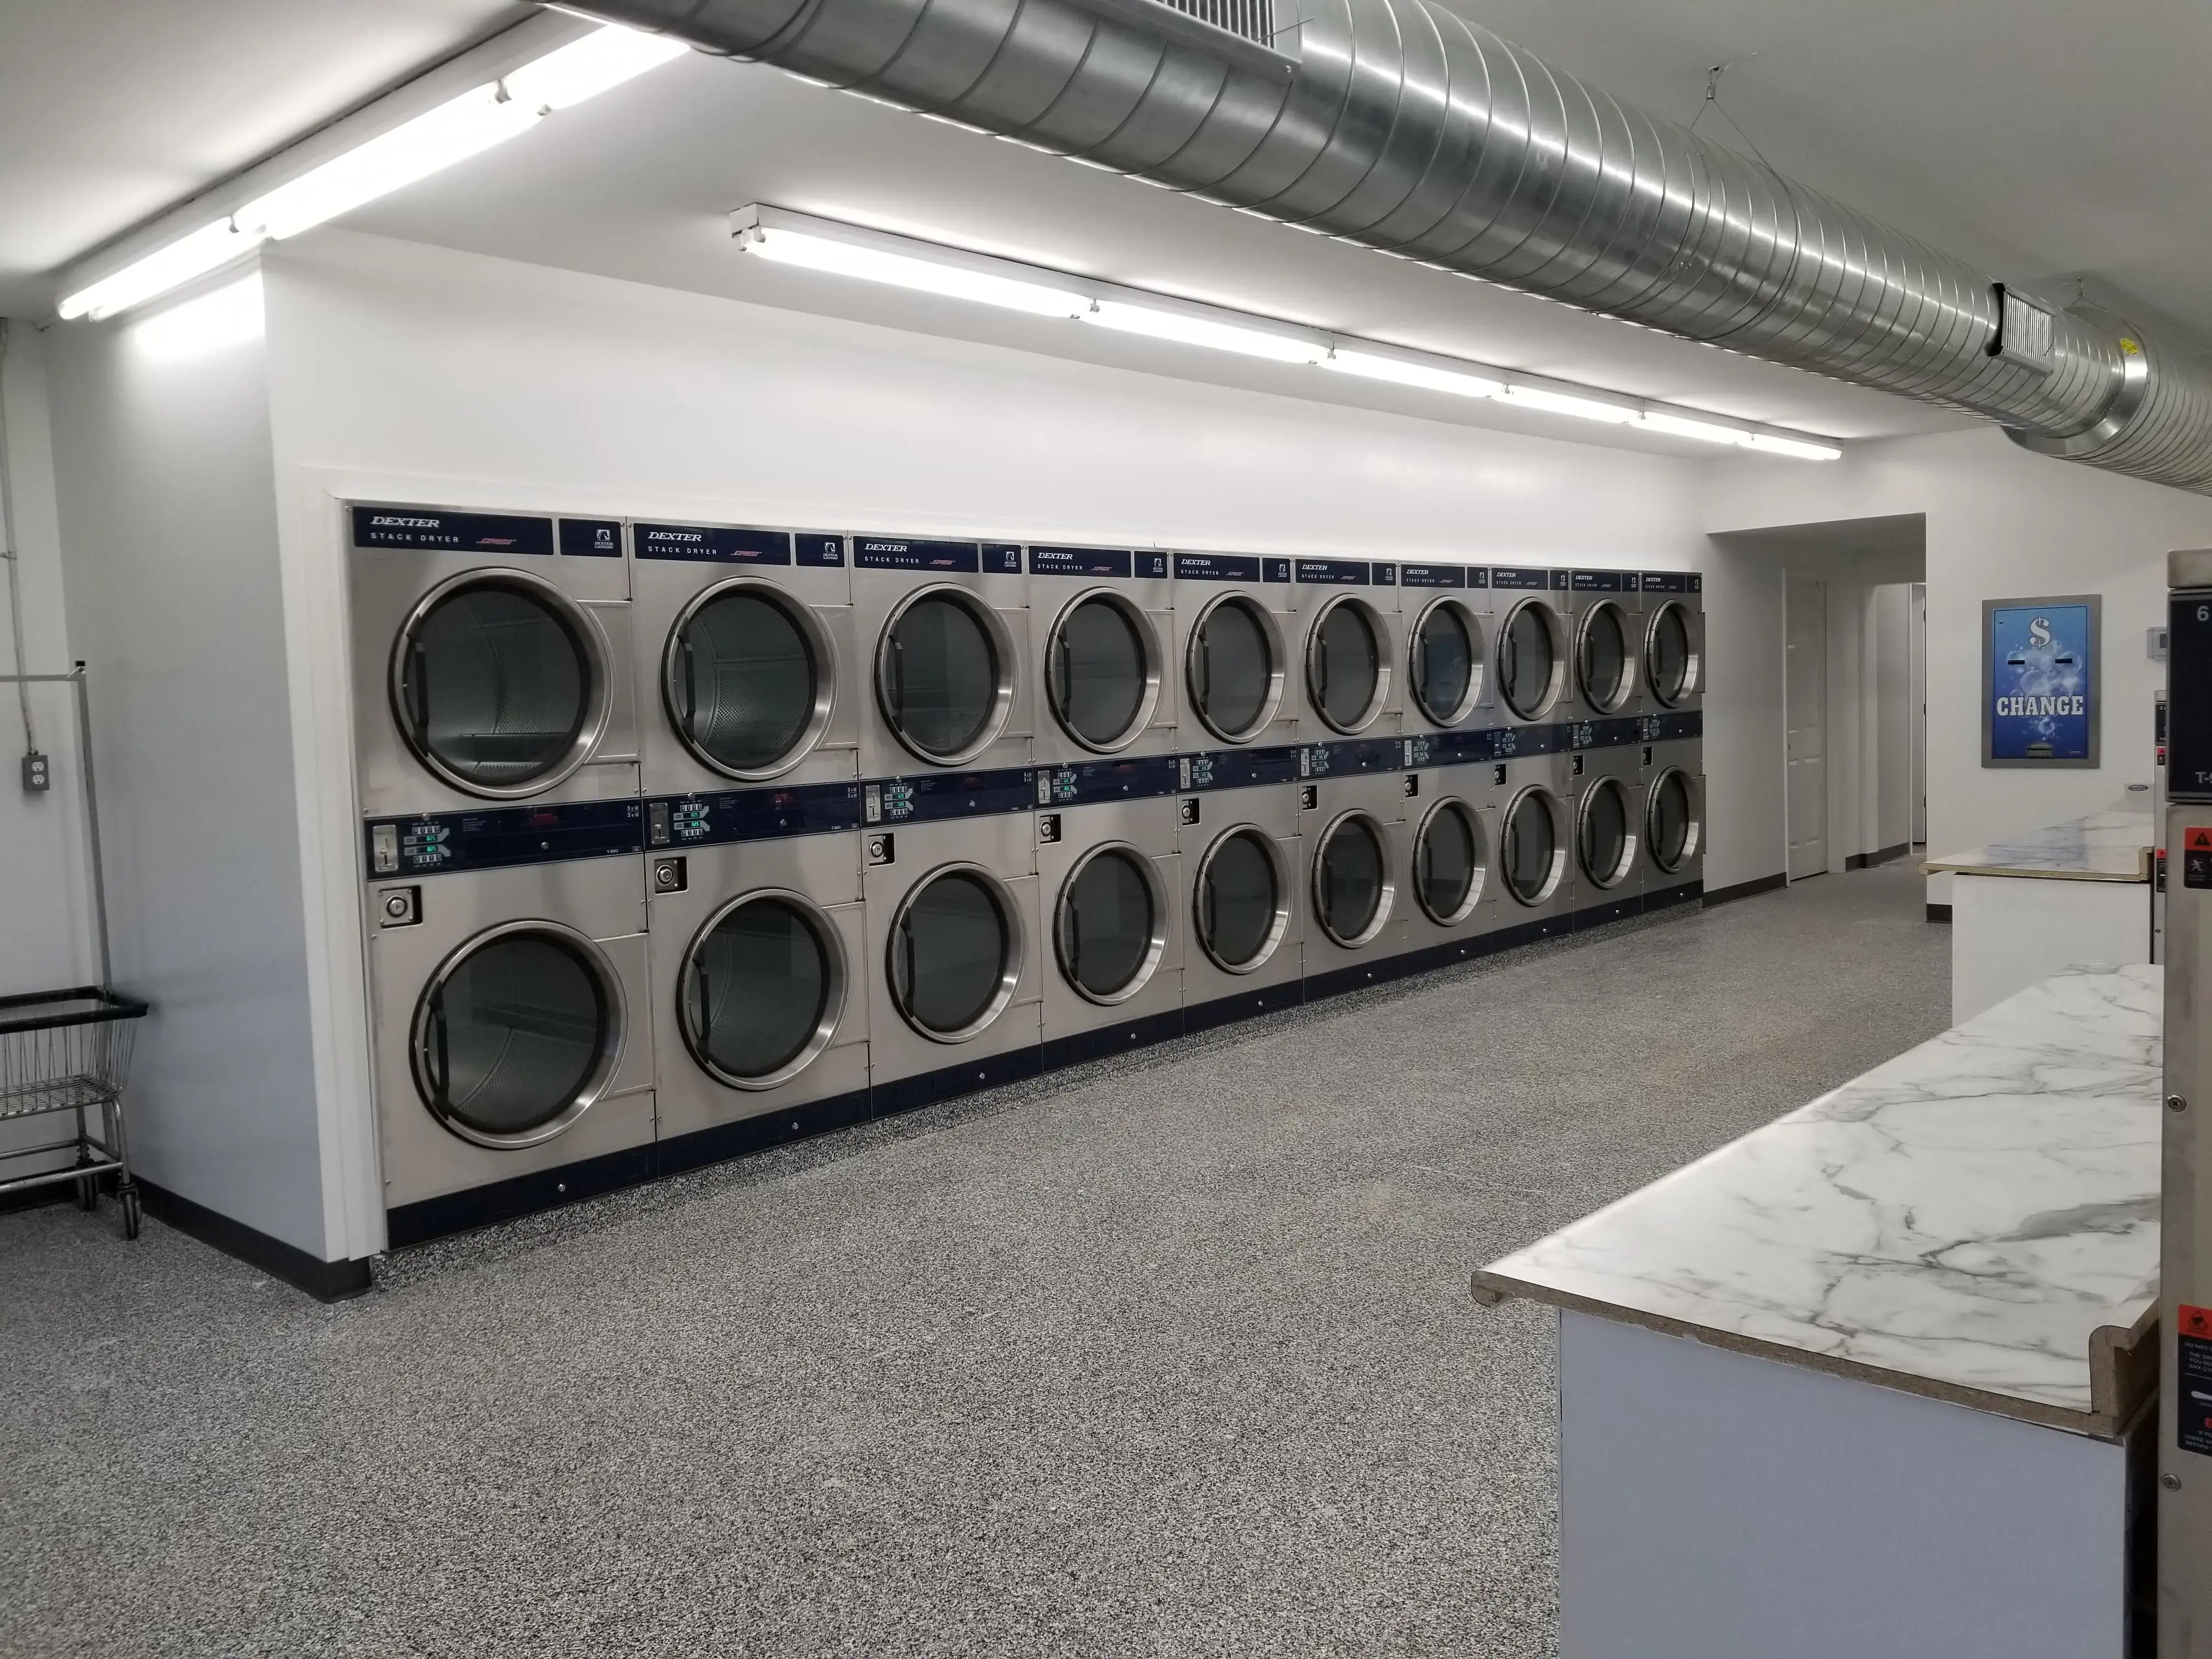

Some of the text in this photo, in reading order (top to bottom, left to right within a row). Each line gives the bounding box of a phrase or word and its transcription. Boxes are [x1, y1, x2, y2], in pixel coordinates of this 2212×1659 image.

[370, 516, 440, 528] DEXTER
[370, 532, 459, 543] STACK DRYER
[647, 532, 702, 541] DEXTER
[864, 543, 907, 552] DEXTER
[1037, 552, 1073, 560] DEXTER
[2030, 616, 2051, 650] $
[1996, 696, 2084, 716] CHANGE
